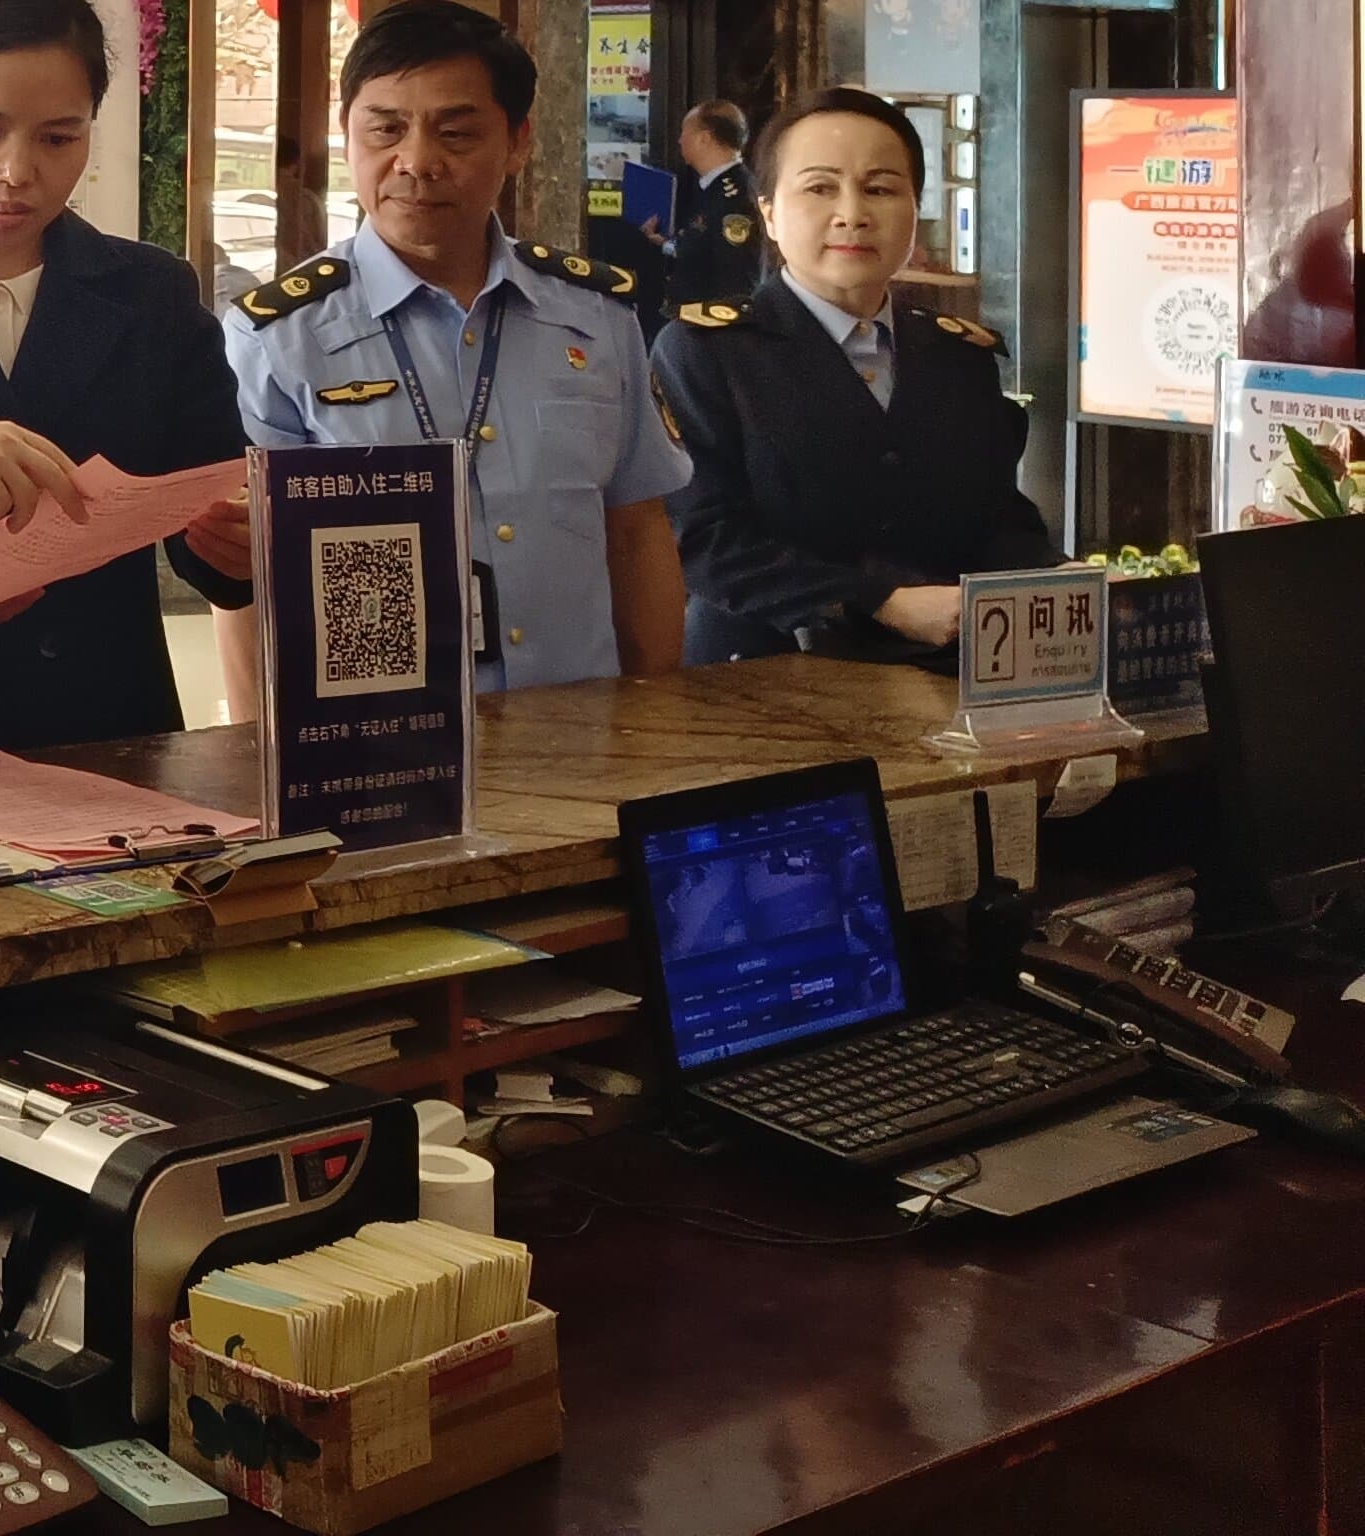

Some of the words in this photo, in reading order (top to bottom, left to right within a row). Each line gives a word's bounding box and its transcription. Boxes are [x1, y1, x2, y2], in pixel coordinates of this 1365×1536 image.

[286, 470, 435, 500] 旅客自助入住二维码
[1028, 592, 1094, 640] 问讯
[1033, 642, 1088, 661] Enquiry
